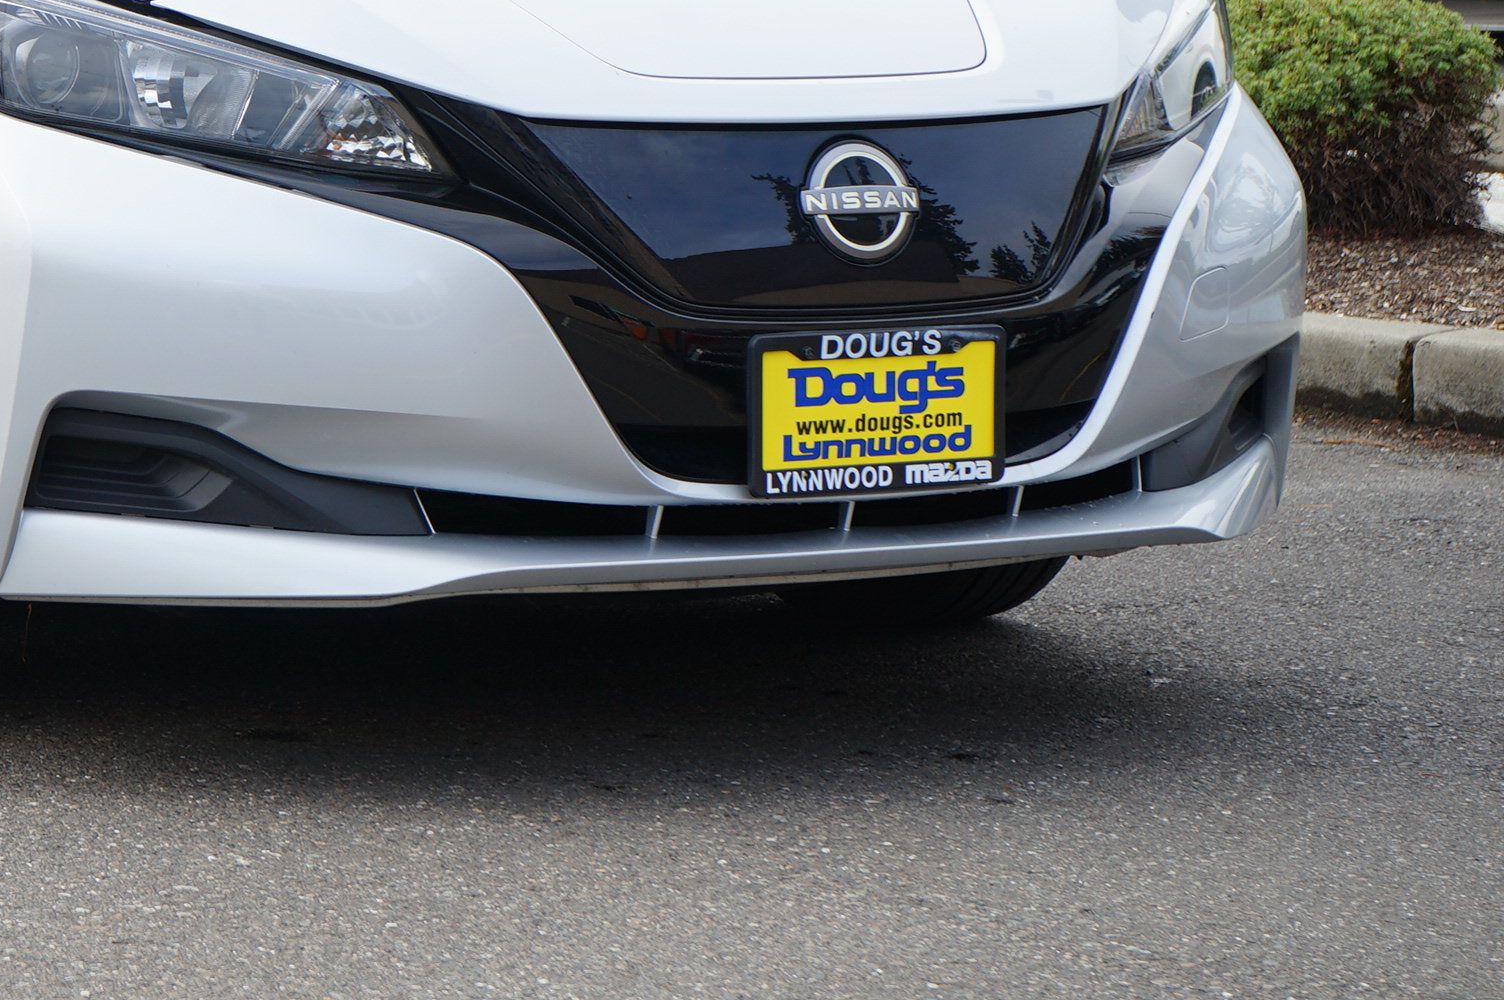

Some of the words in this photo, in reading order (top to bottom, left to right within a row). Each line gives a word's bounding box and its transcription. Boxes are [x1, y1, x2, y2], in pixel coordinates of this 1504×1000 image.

[805, 190, 918, 212] NISSAN
[820, 330, 942, 360] DOUG'S
[787, 361, 965, 414] Doug's
[796, 411, 963, 435] www.dougs.com
[782, 425, 971, 462] Lynnwood
[766, 466, 894, 494] LYNNWOOD
